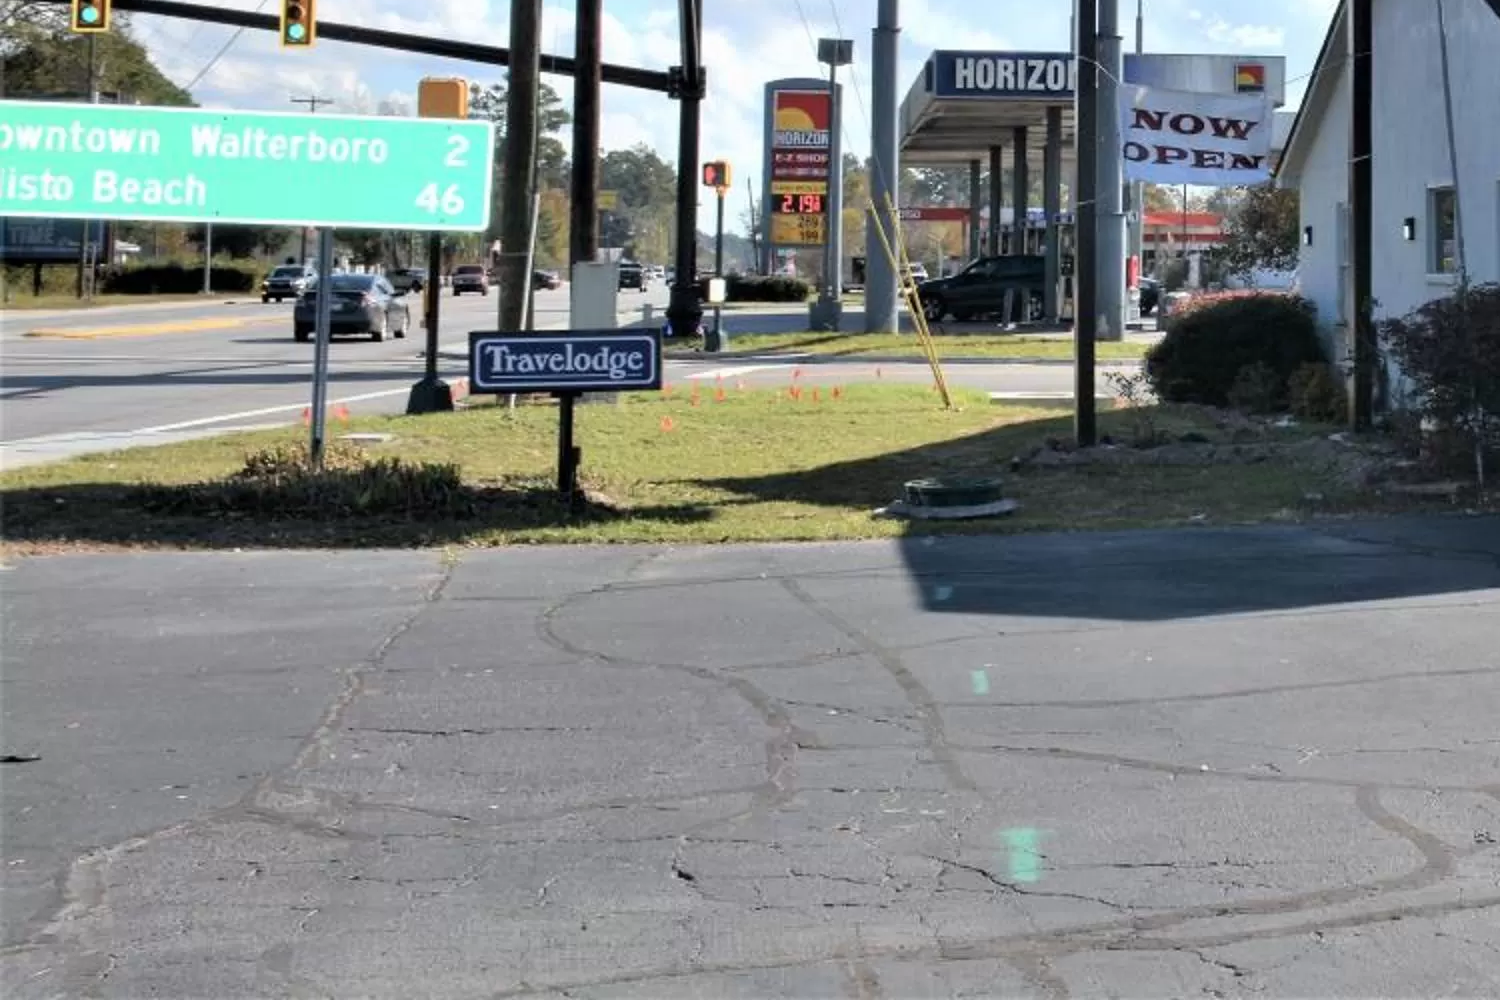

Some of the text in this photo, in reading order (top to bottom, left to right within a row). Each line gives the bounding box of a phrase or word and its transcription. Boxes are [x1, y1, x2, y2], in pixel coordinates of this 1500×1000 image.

[1129, 107, 1260, 141] NOW
[191, 124, 389, 164] Walterboro
[444, 134, 470, 167] 2
[1123, 141, 1265, 171] OPEN
[0, 168, 465, 215] isto Beach 46
[484, 343, 644, 379] Travelodge
